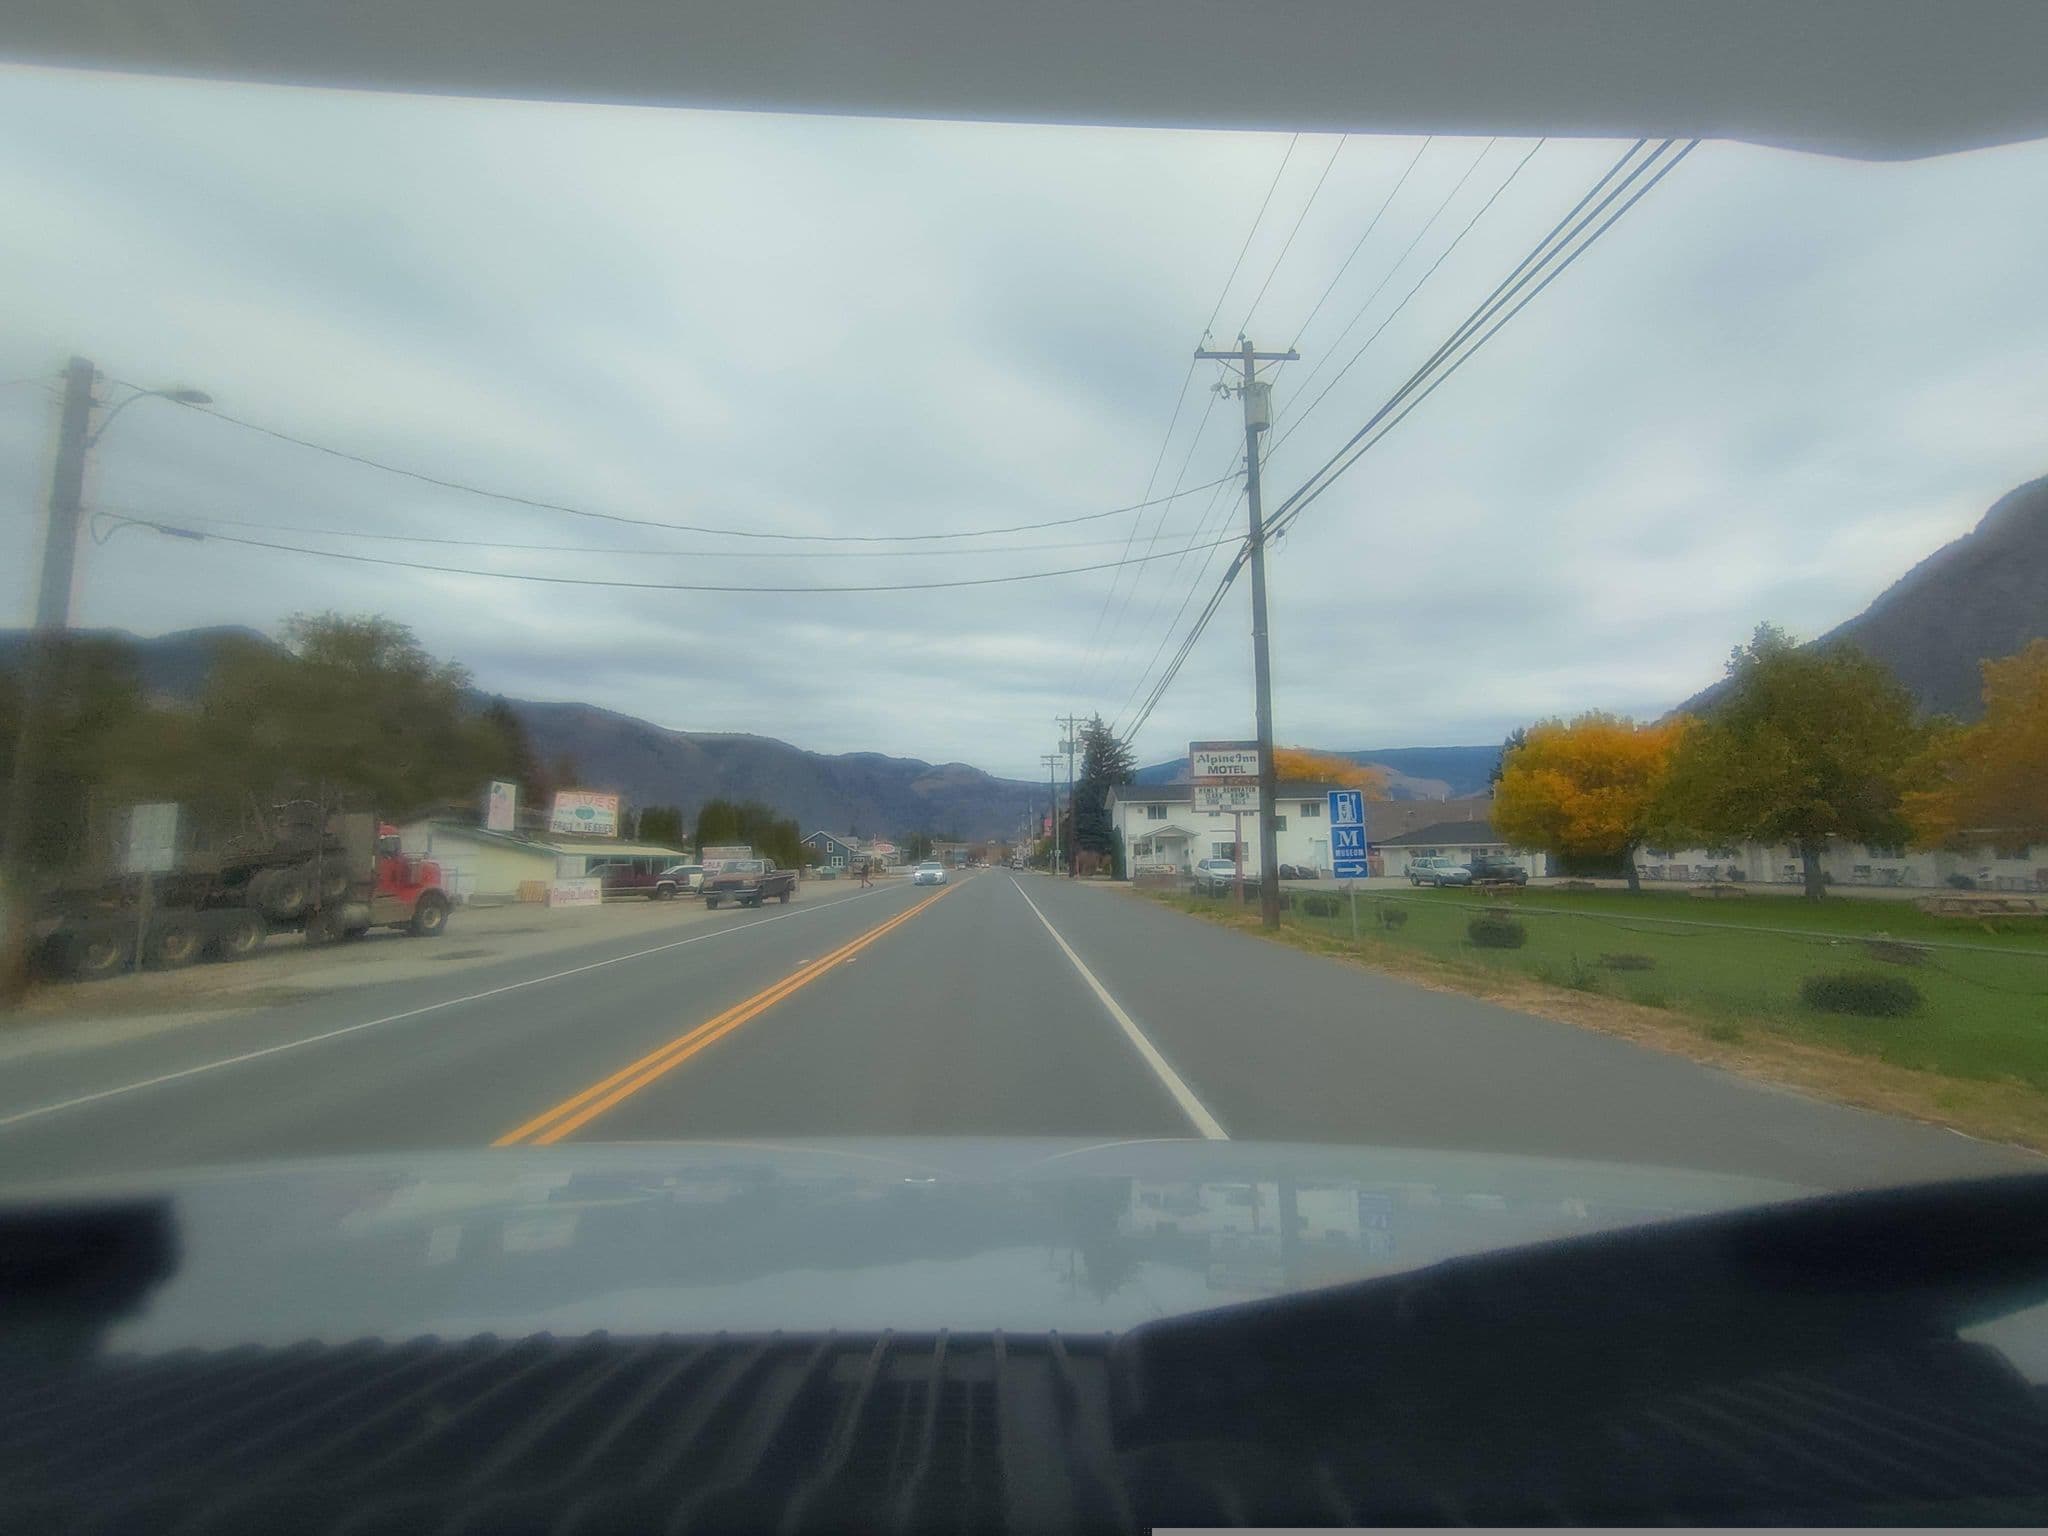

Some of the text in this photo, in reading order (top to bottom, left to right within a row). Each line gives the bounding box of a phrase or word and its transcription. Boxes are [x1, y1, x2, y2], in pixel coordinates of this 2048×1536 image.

[1196, 753, 1257, 766] Alpine Inn
[1208, 765, 1247, 774] MOTEL
[1337, 831, 1361, 847] M
[1335, 848, 1364, 857] MUSEUM
